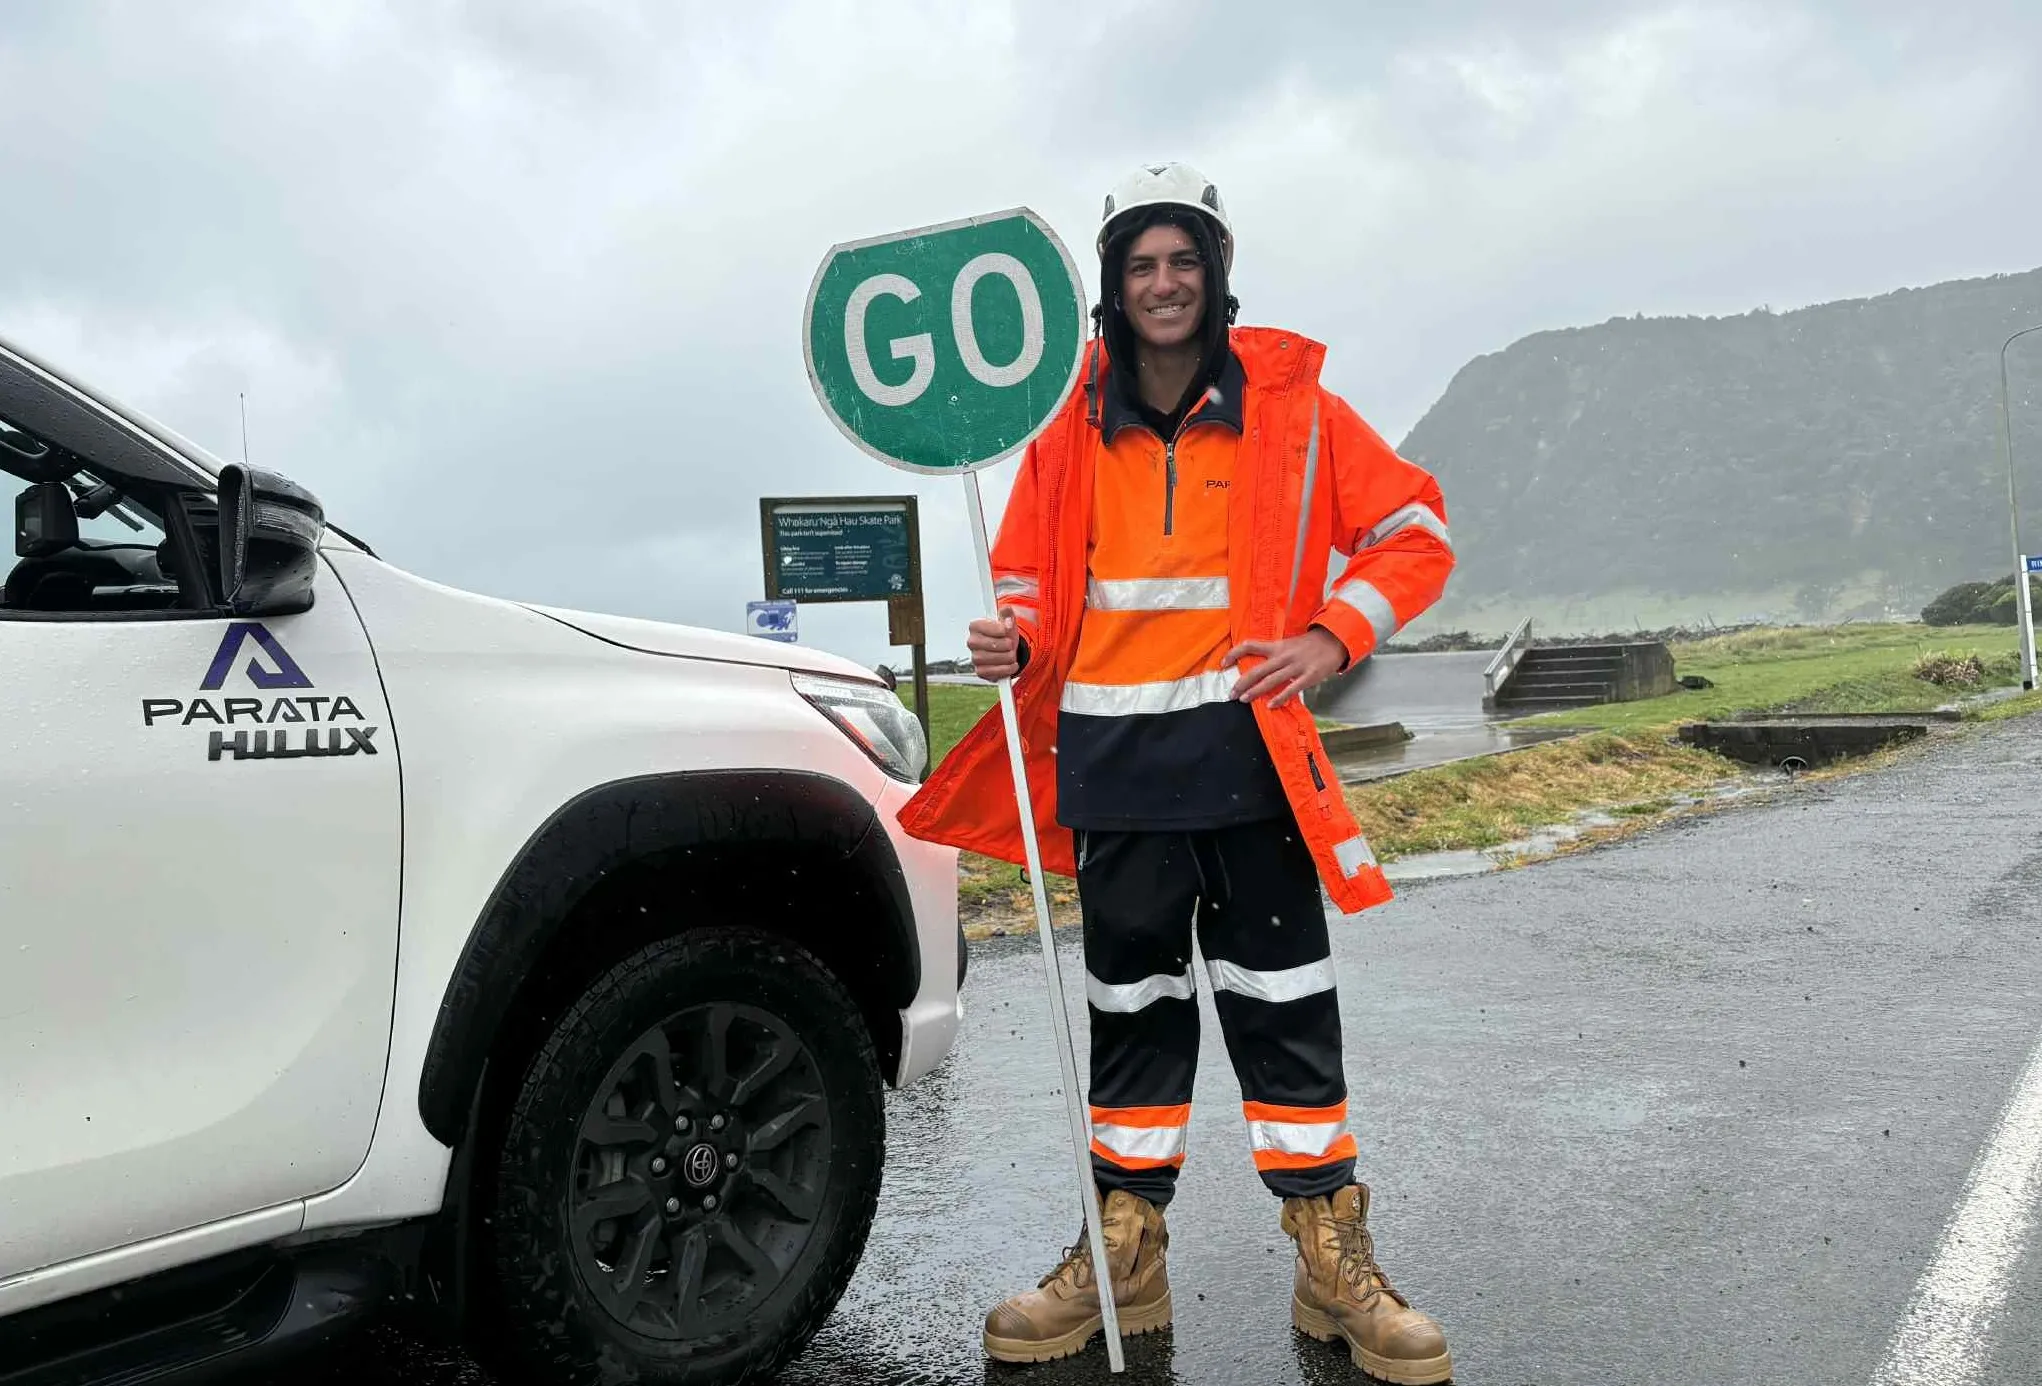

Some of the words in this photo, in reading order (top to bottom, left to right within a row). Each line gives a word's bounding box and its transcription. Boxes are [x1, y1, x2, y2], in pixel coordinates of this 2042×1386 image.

[844, 252, 1044, 407] GO
[859, 515, 882, 526] Skate
[884, 514, 902, 525] Park
[782, 587, 793, 595] Call
[142, 697, 365, 726] PARATA
[208, 726, 378, 761] HILUX
